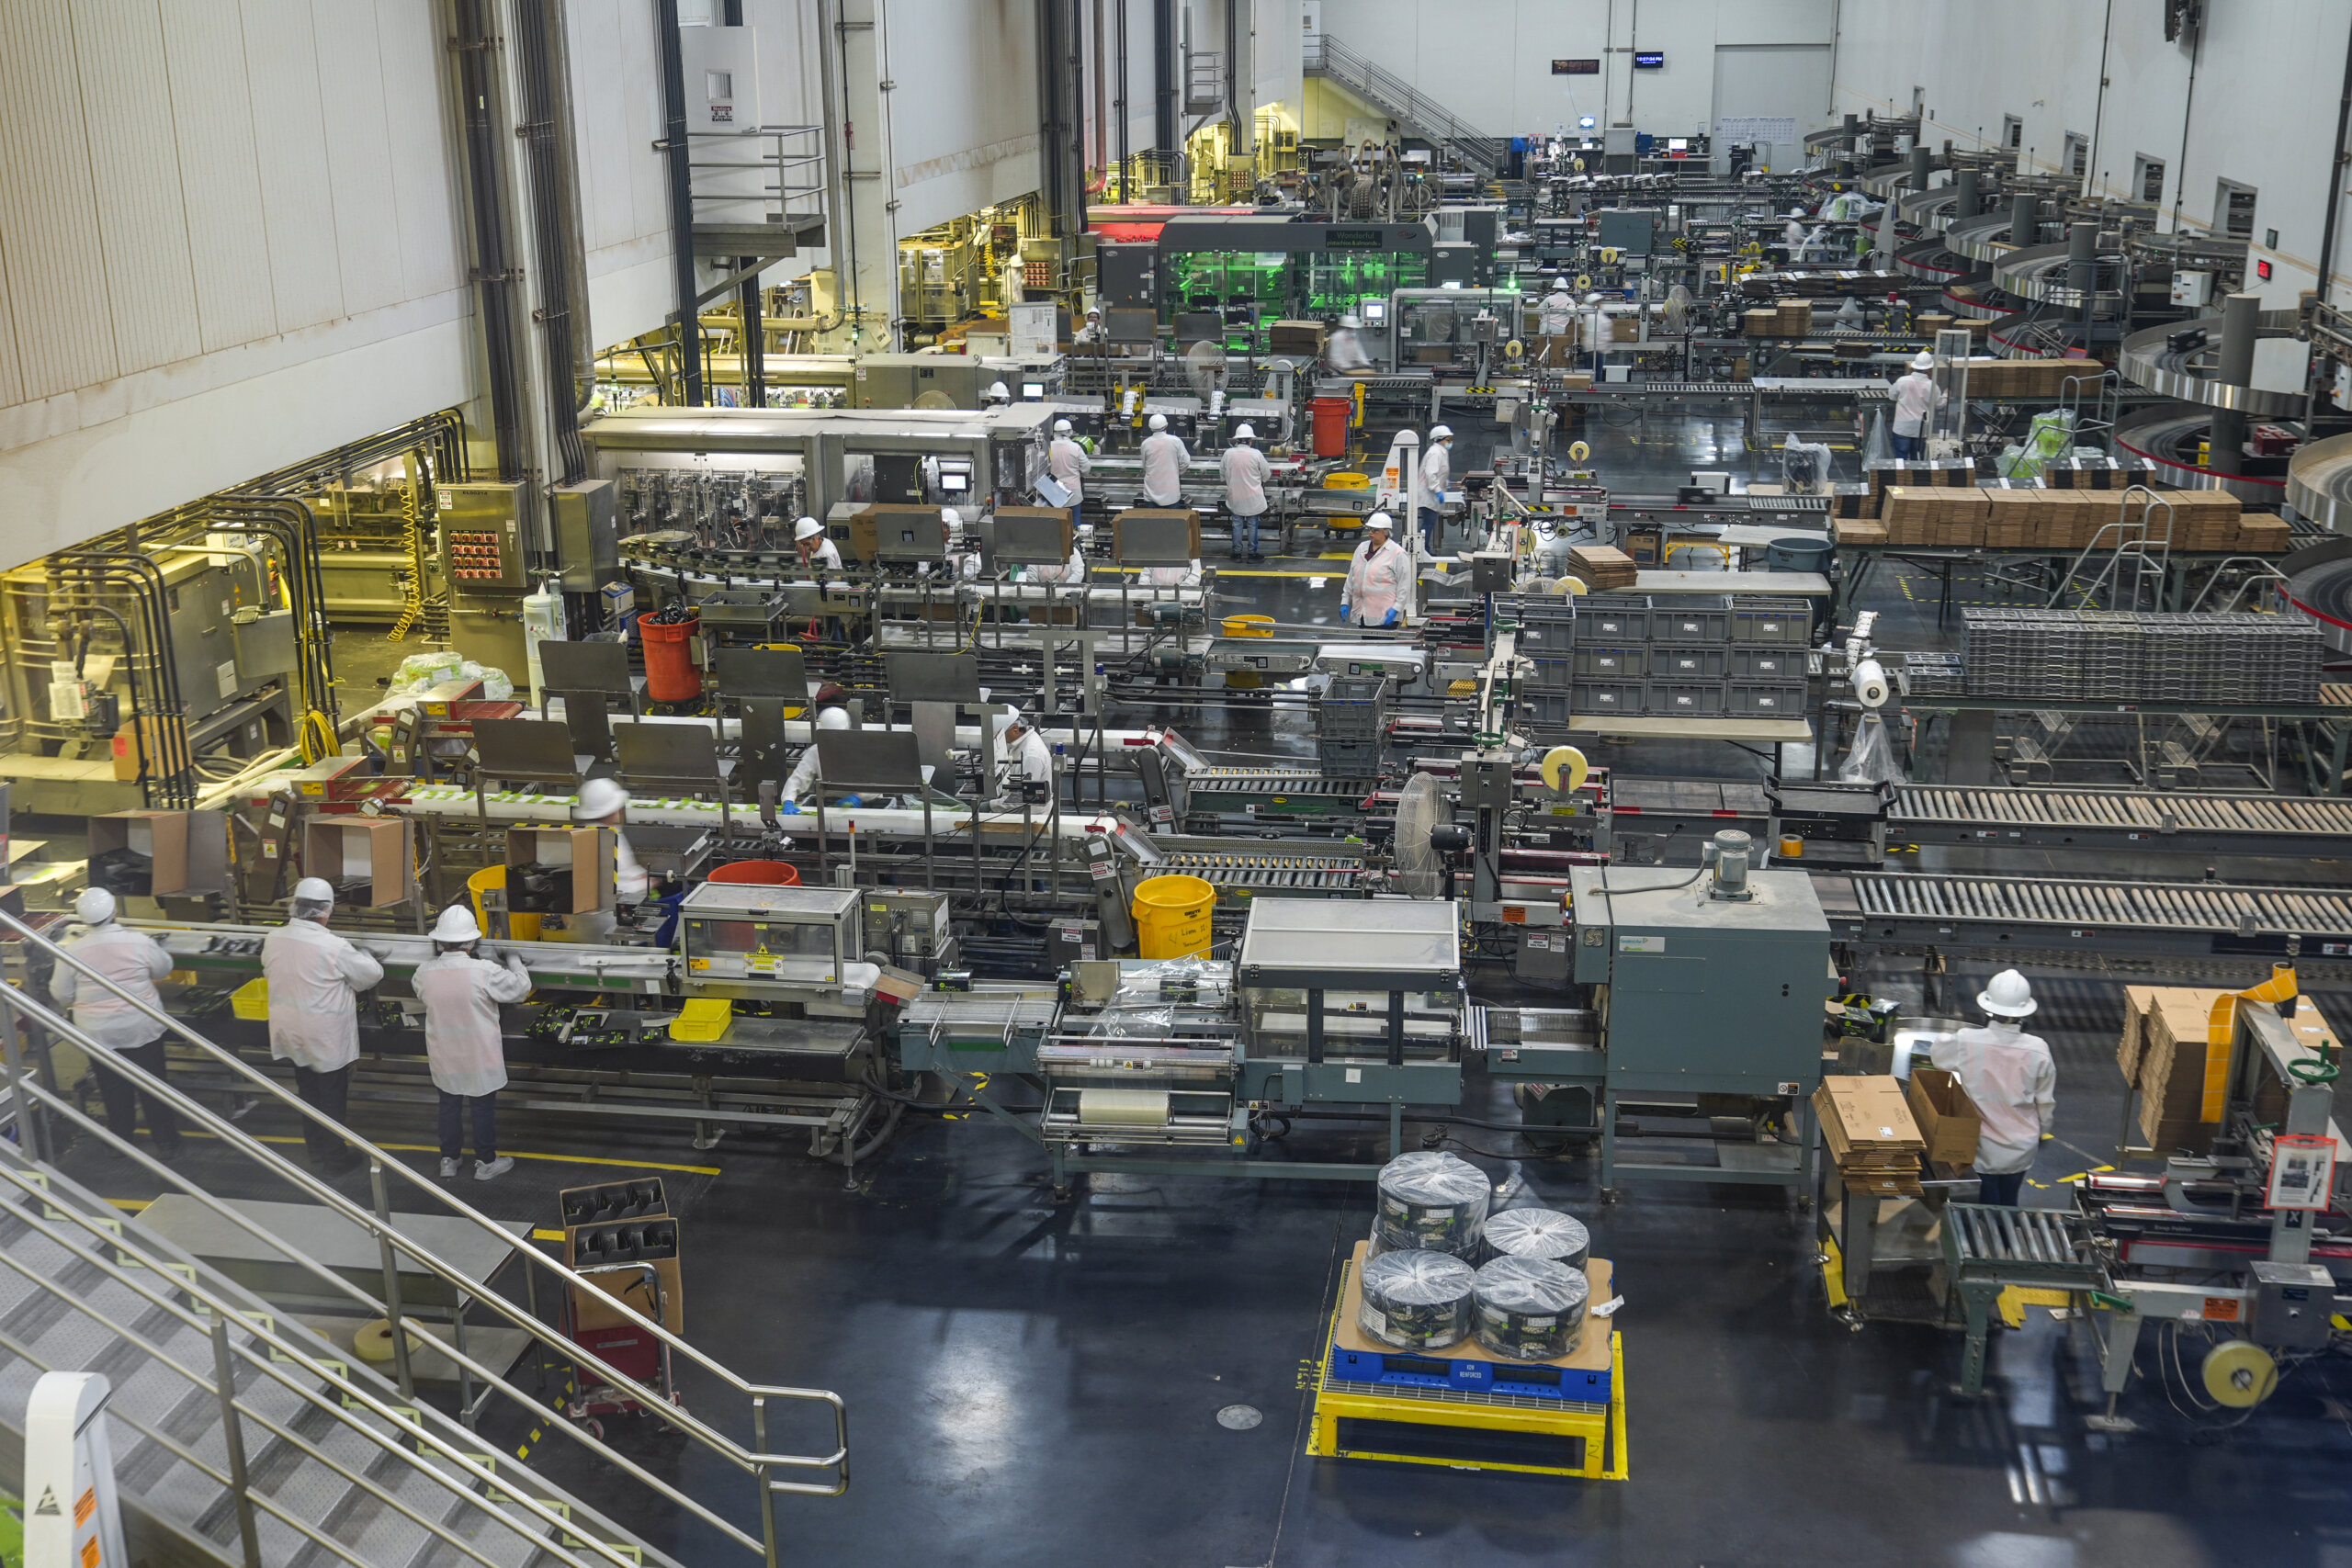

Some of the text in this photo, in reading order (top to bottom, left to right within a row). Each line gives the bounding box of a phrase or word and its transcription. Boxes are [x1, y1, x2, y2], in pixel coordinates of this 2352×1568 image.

[1337, 231, 1374, 239] Wonderful
[1459, 1371, 1483, 1379] REINFORCED
[1588, 1444, 1600, 1460] 2
